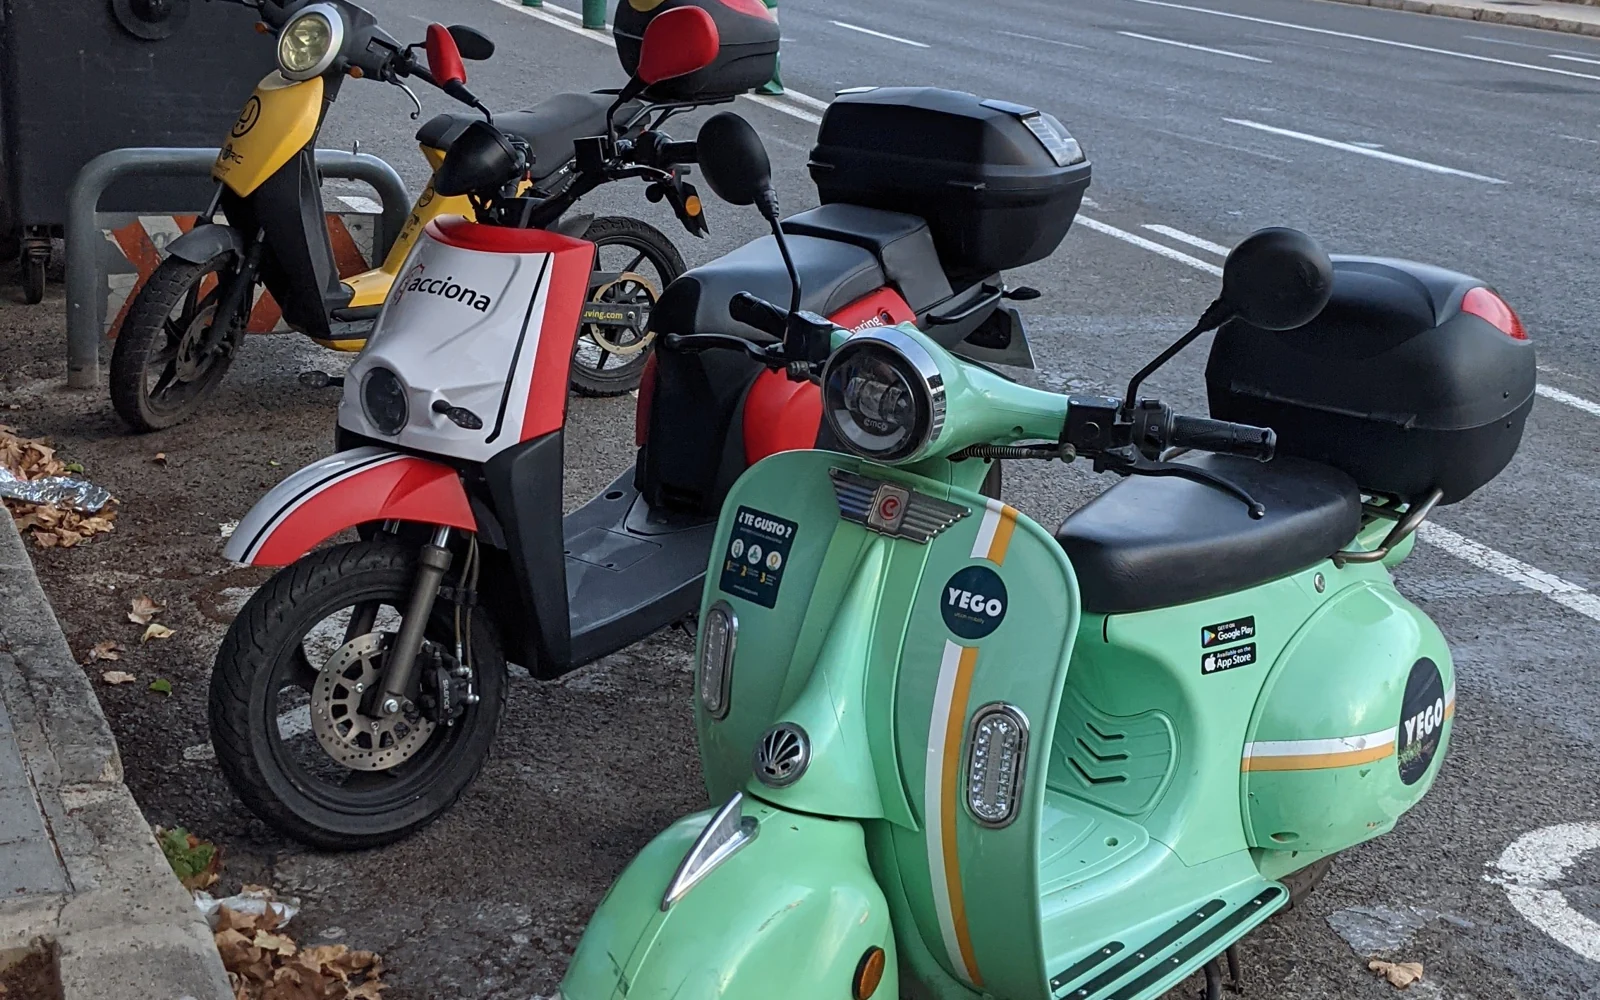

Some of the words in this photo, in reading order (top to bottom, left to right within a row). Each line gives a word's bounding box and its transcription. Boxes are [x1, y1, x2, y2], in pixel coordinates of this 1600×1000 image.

[407, 276, 492, 313] acciona
[948, 586, 1003, 618] YEGO
[1217, 628, 1241, 641] Google
[1240, 625, 1254, 636] Play
[1216, 649, 1237, 659] Available
[1216, 658, 1232, 670] App
[1232, 653, 1252, 665] Store
[1404, 697, 1444, 746] YEGO
